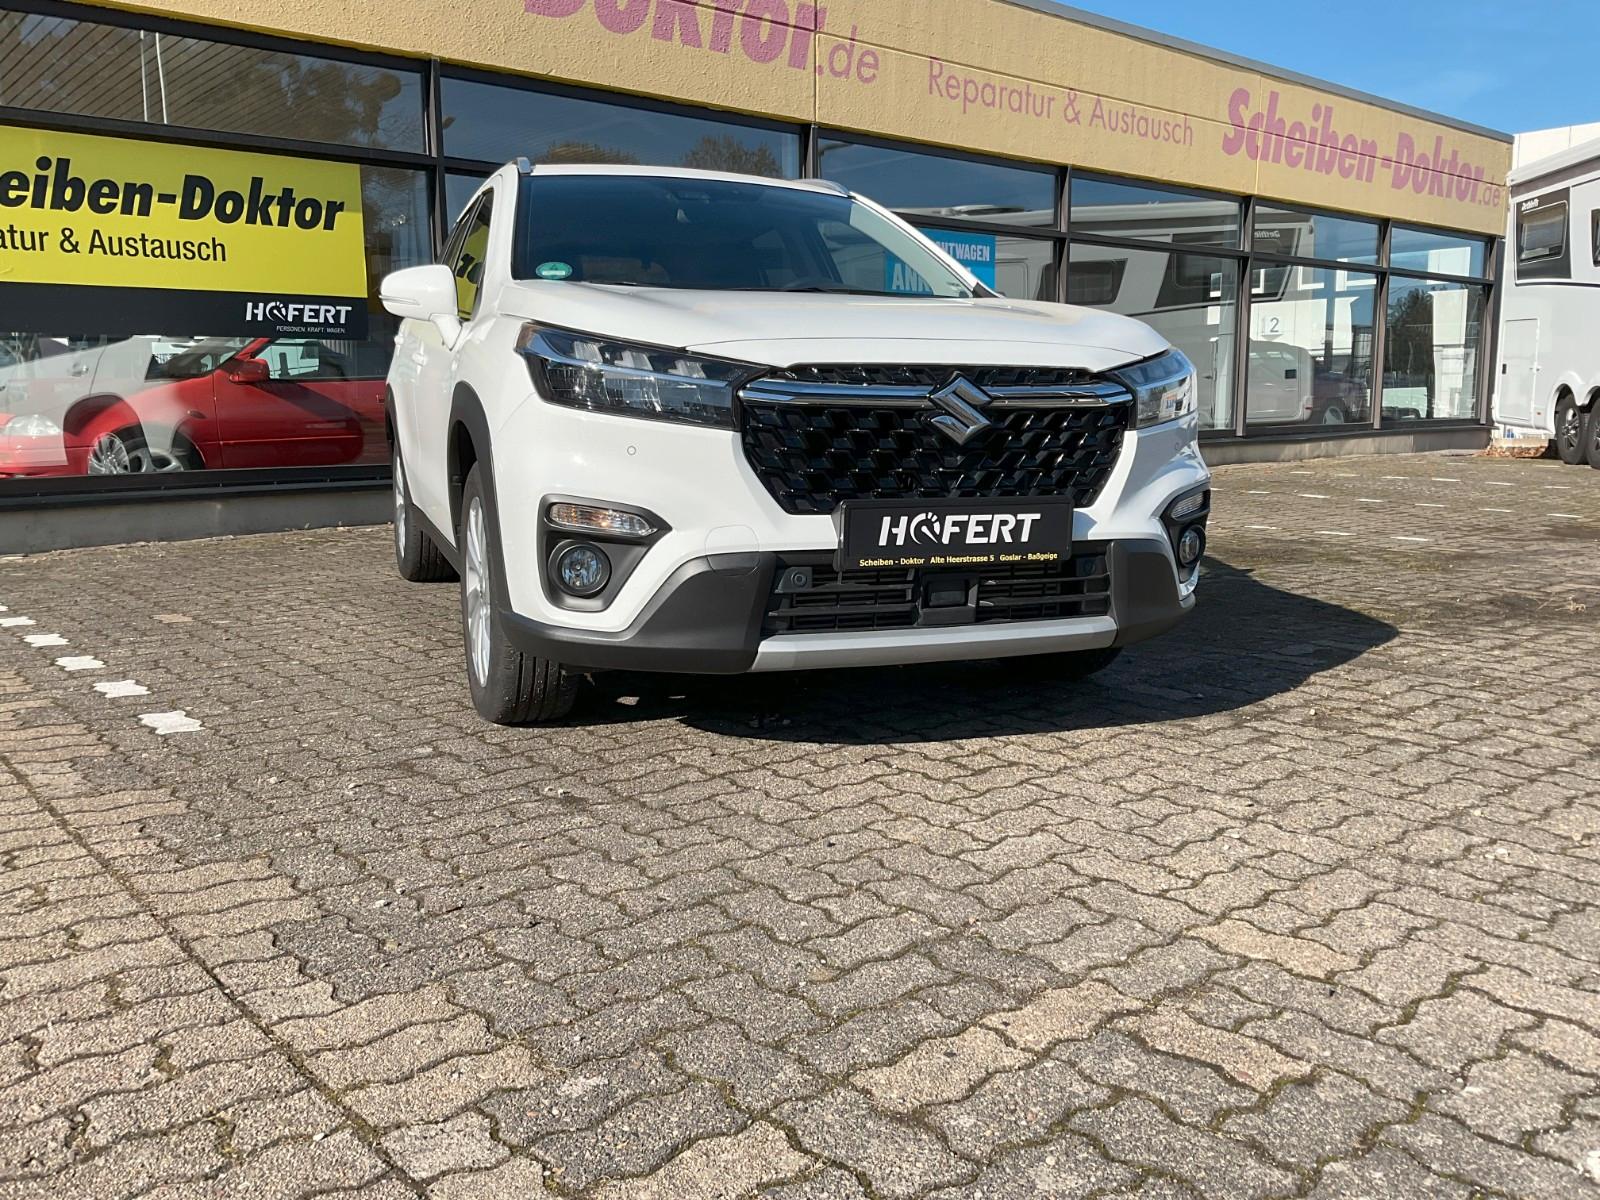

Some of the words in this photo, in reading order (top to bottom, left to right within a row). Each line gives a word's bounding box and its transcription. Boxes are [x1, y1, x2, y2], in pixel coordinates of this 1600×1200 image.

[928, 56, 1055, 114] Reparatur
[1063, 88, 1081, 125] &
[1089, 93, 1193, 147] Austausch
[59, 227, 80, 254] &
[88, 229, 227, 262] Austausch
[1269, 317, 1280, 333] 2
[859, 558, 894, 567] Scheiben
[900, 557, 925, 566] Doktor
[930, 556, 945, 565] Alte
[946, 555, 988, 564] Heerstrasse
[990, 554, 995, 562] 5
[1000, 553, 1022, 562] Goslar
[1027, 551, 1058, 562] Baßgeige
